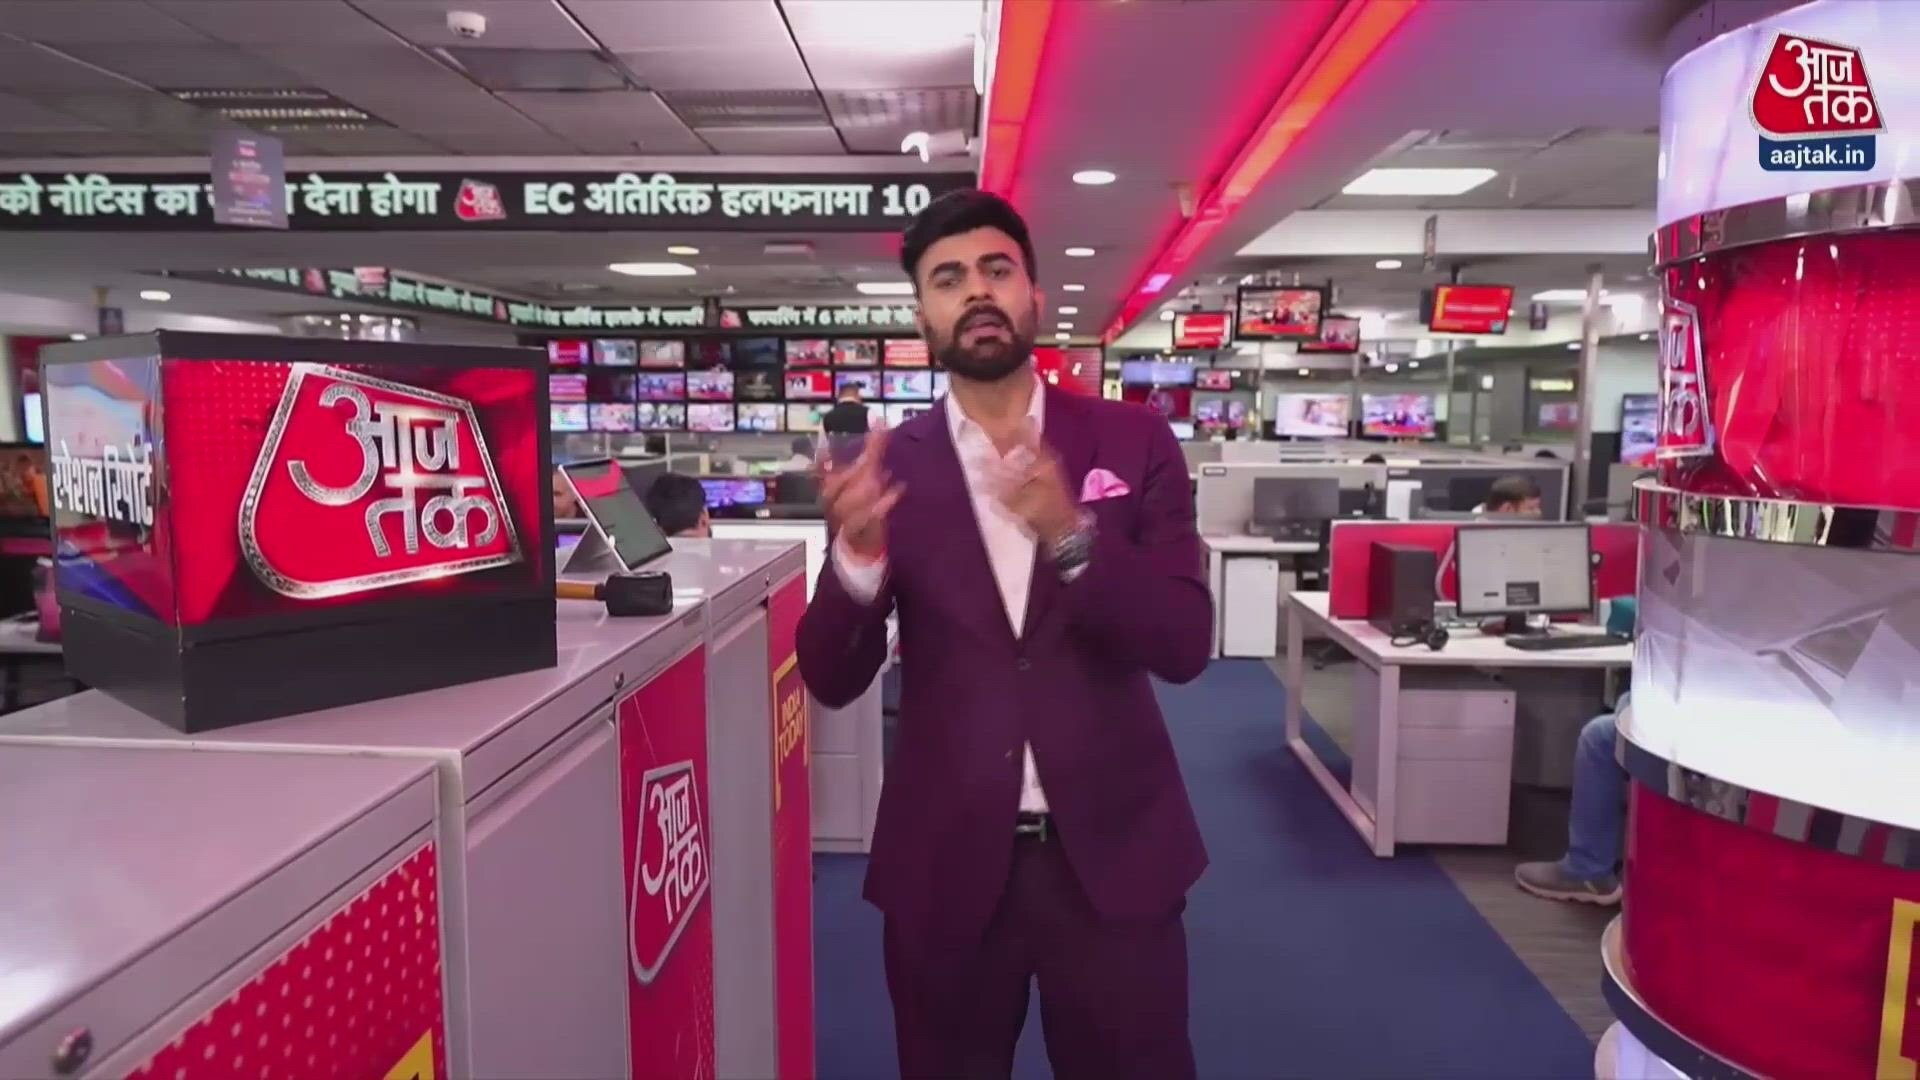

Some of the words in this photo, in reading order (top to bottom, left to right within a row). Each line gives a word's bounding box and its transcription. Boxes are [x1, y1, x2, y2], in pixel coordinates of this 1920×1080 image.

[0, 174, 42, 215] को
[48, 174, 147, 215] नोटिस
[152, 184, 199, 215] का
[302, 173, 362, 215] देना
[367, 173, 441, 216] होगा
[524, 183, 574, 214] EC
[584, 173, 711, 214] अतिरिक्त
[718, 184, 872, 217] हलफनामा
[882, 184, 931, 215] 10
[51, 438, 105, 518] स्पेशल
[103, 442, 154, 526] रिपोर्ट
[288, 384, 458, 506] आज
[364, 475, 498, 556] तक
[641, 774, 690, 896] आज
[664, 823, 702, 924] तक
